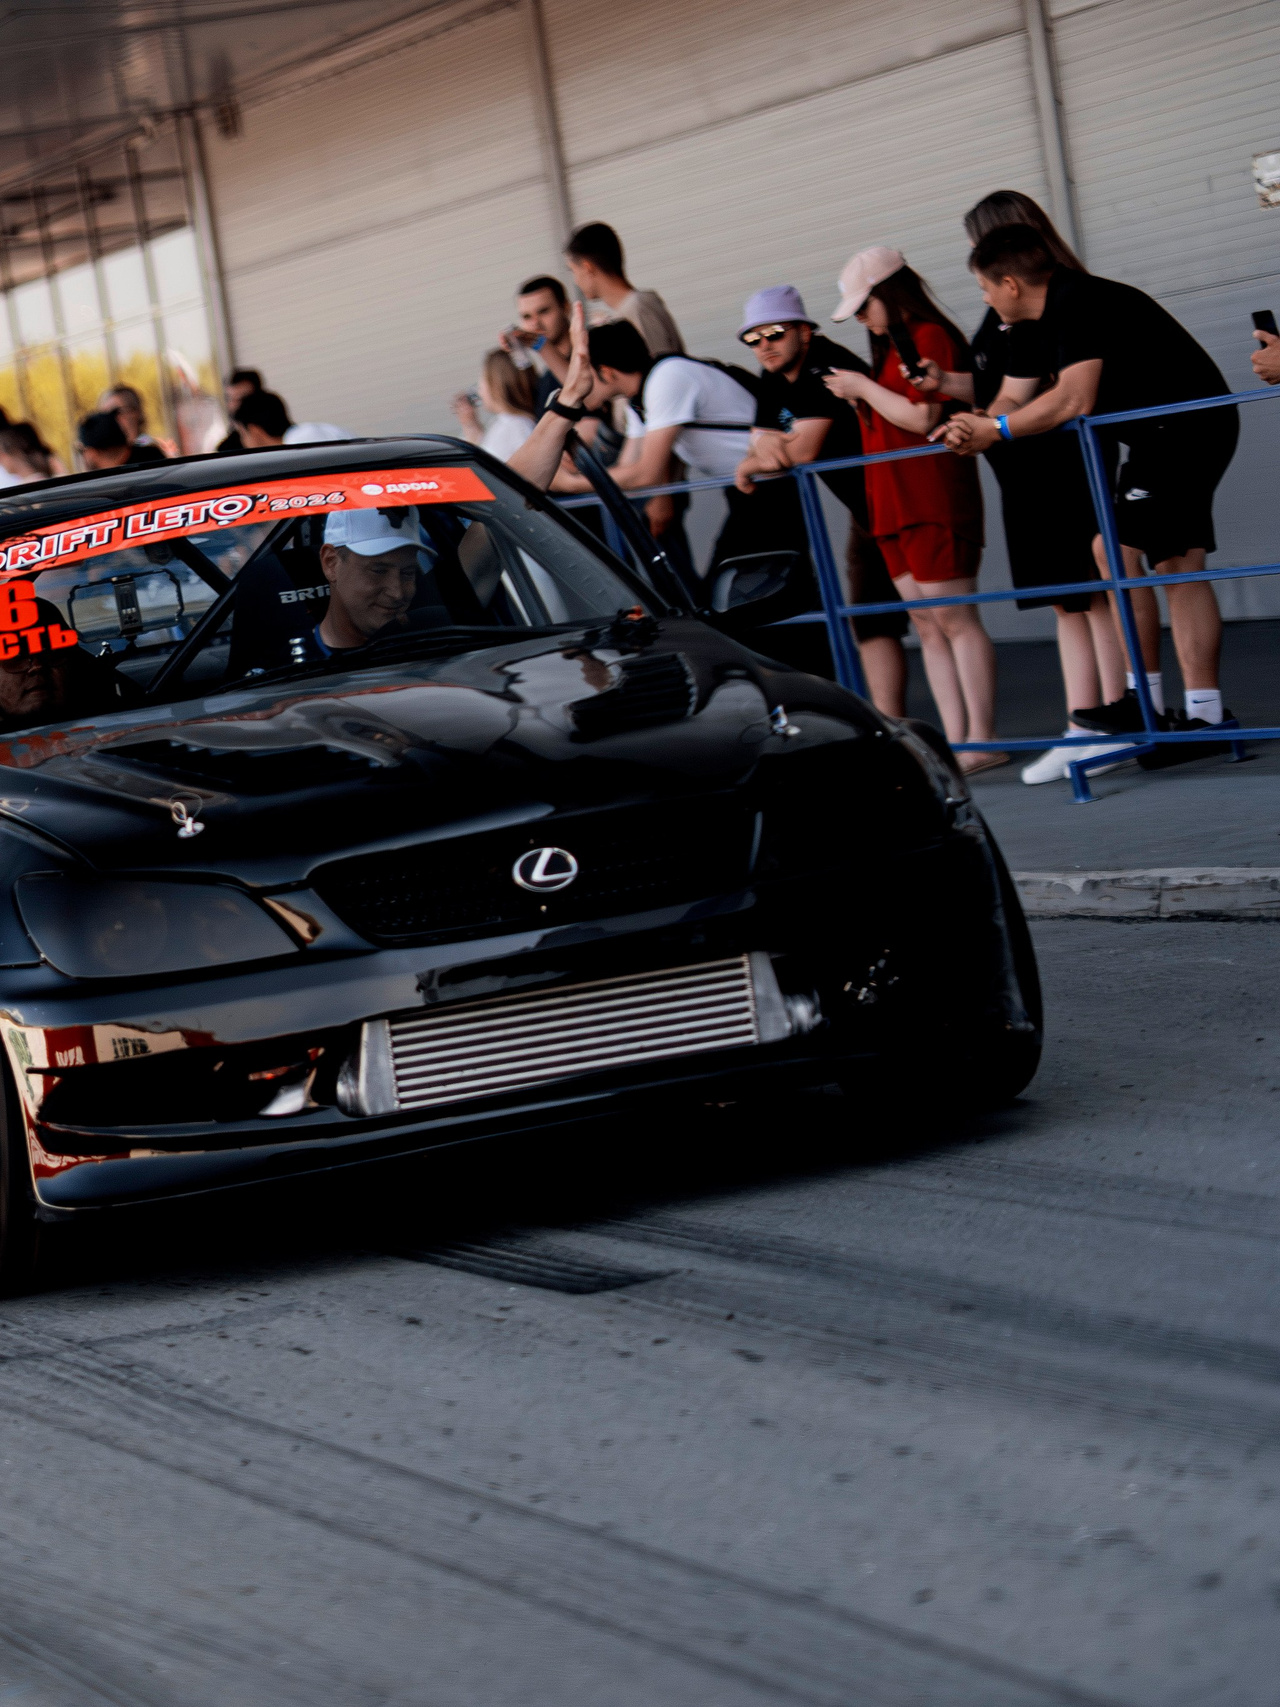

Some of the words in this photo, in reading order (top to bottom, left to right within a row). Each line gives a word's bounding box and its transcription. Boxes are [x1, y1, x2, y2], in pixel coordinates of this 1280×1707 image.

[385, 481, 439, 494] дром
[124, 494, 254, 539] LETO
[269, 491, 345, 512] 2026
